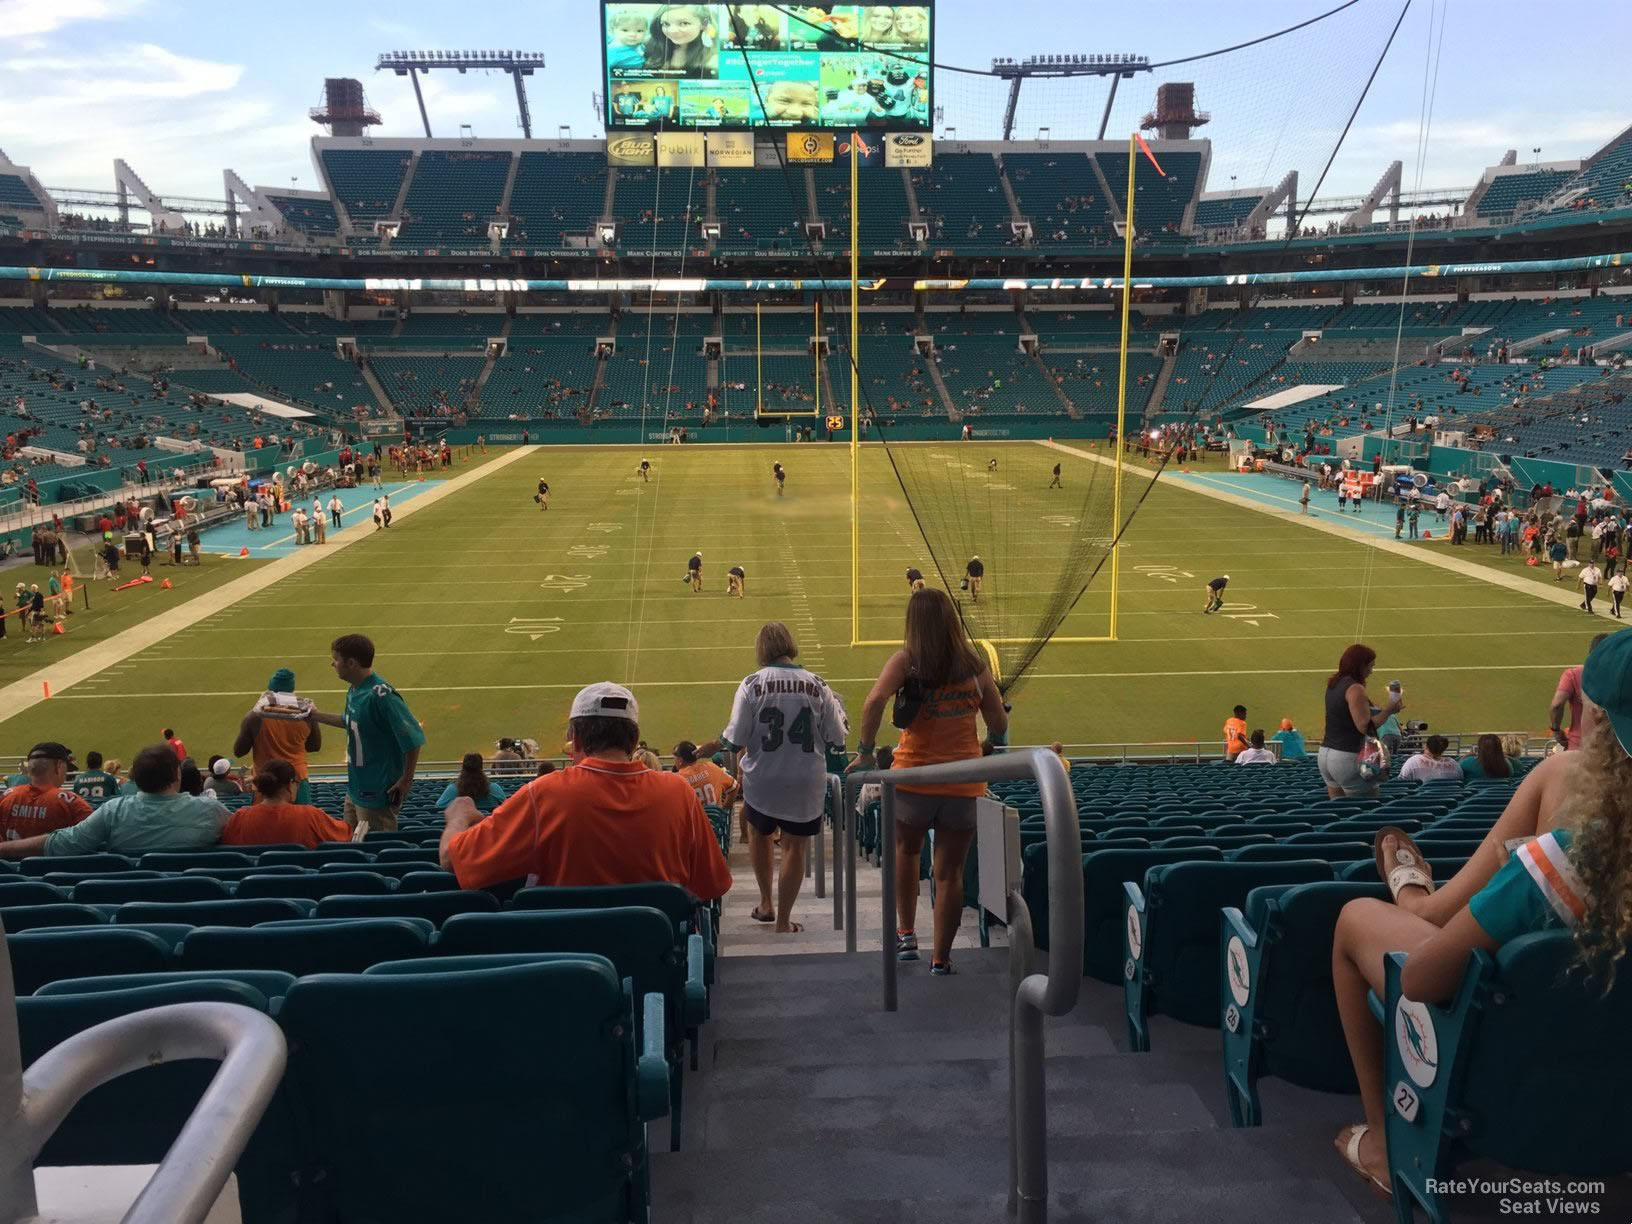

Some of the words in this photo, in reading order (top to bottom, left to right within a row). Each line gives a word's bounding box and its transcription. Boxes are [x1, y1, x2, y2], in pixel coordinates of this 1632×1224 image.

[620, 140, 652, 150] BUD
[898, 135, 919, 145] Ford
[660, 143, 699, 155] Publix
[82, 235, 125, 243] STEPHENSON
[828, 418, 843, 428] 25
[759, 706, 815, 753] 34
[11, 803, 48, 820] SMITH
[1227, 1008, 1238, 1027] 26
[1397, 1088, 1415, 1112] 27
